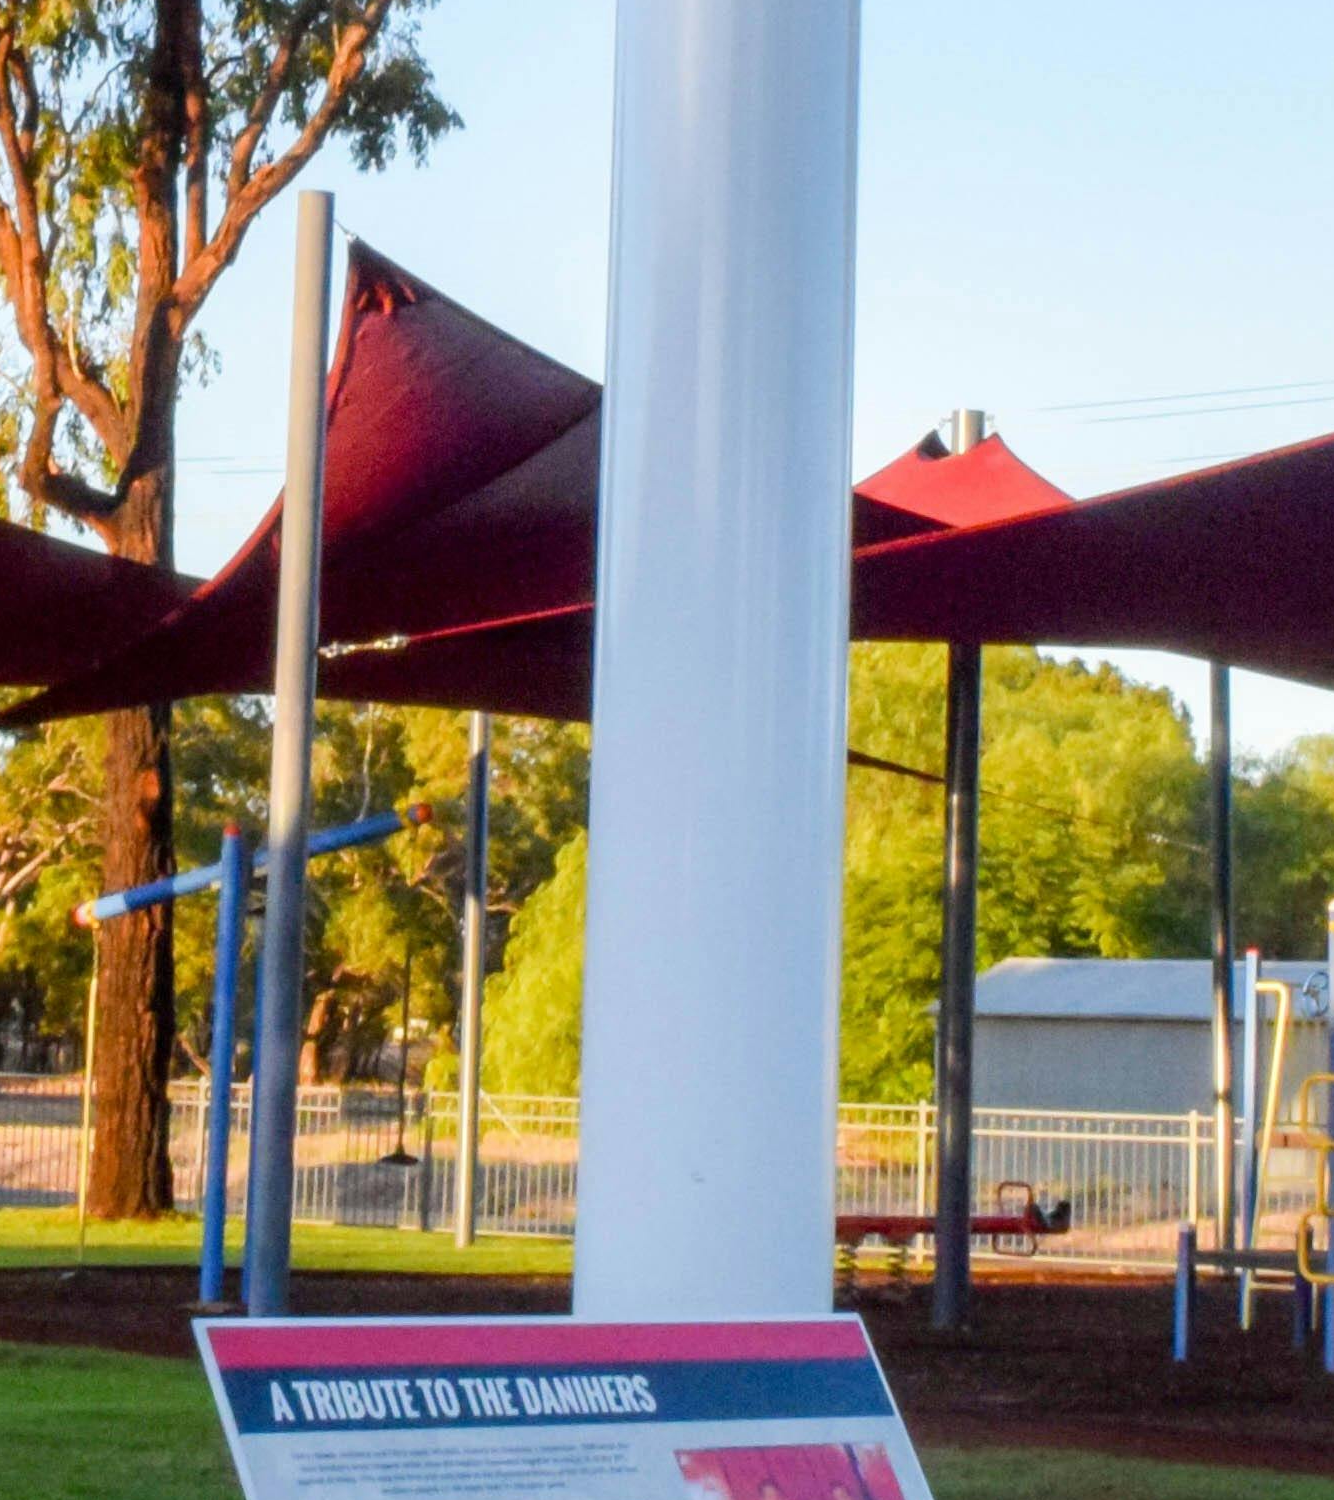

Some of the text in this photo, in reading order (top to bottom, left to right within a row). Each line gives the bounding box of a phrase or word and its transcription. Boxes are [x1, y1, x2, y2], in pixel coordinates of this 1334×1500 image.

[269, 1373, 658, 1424] A TRIBUTE TO THE DANIHERS
